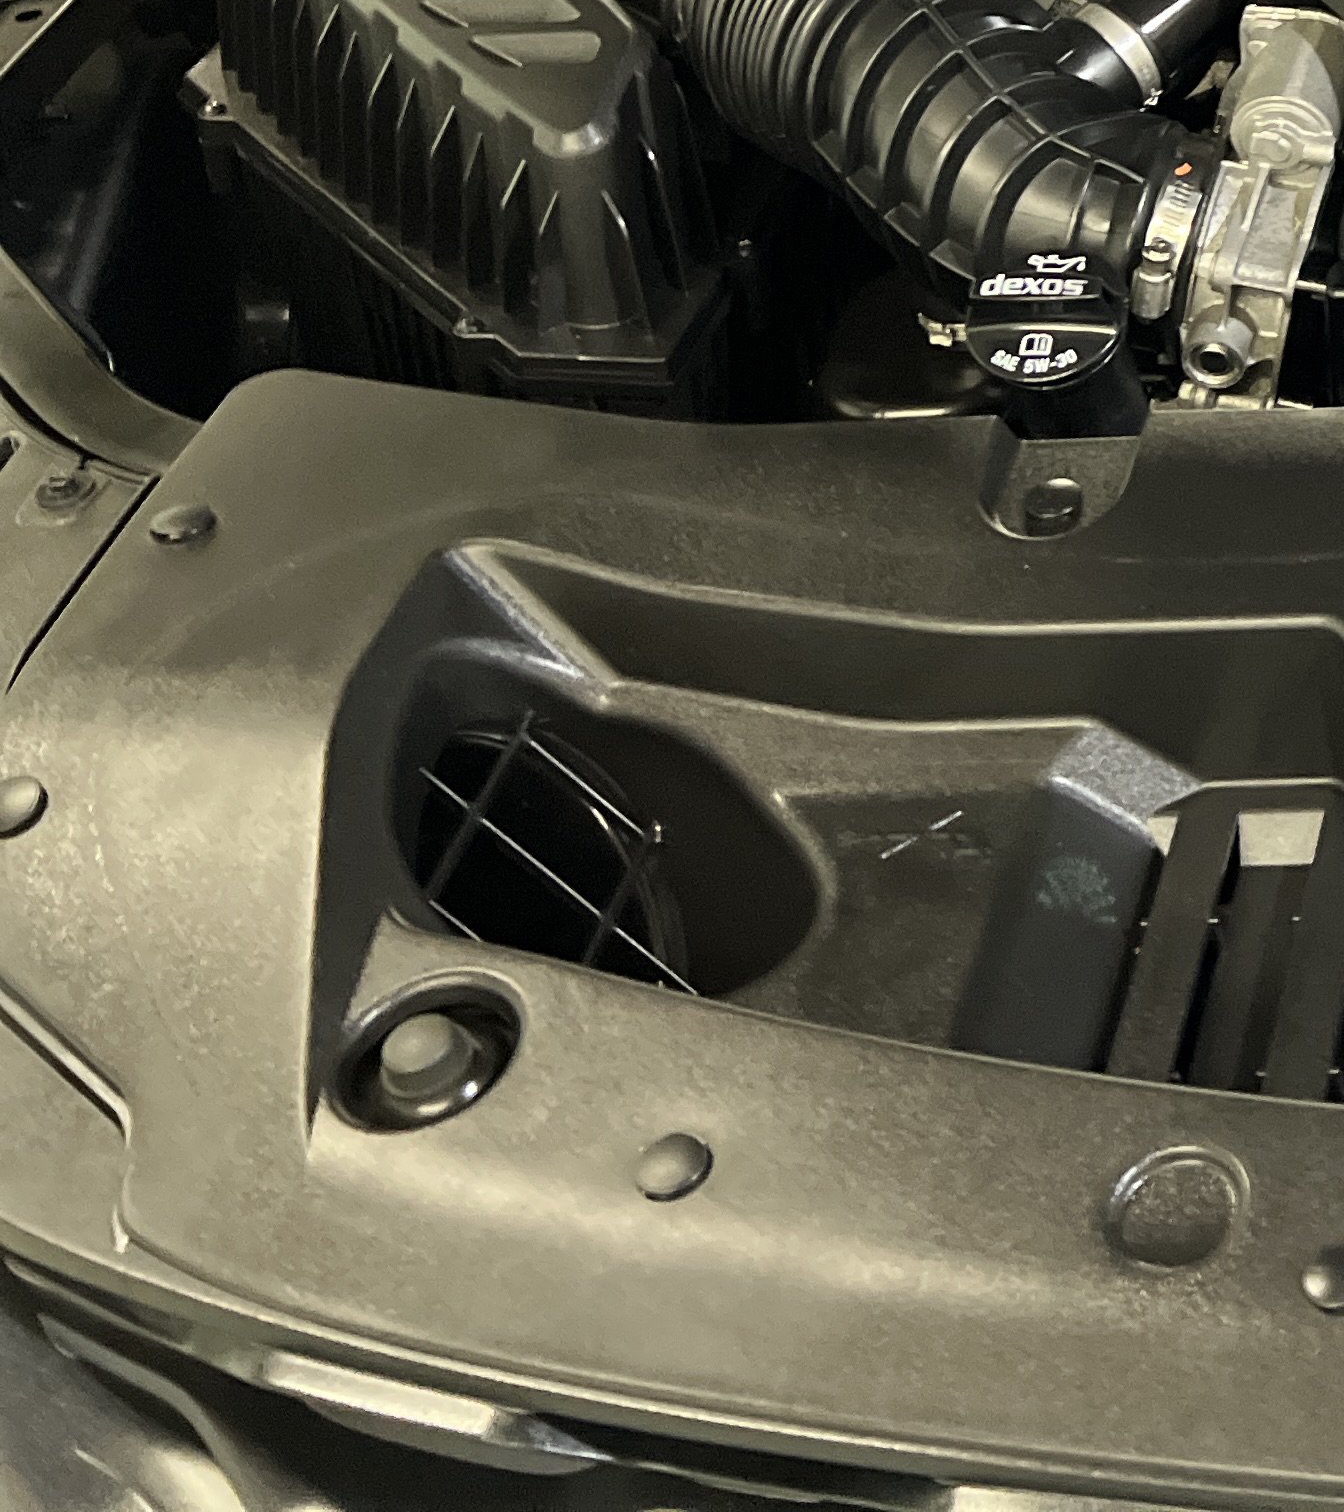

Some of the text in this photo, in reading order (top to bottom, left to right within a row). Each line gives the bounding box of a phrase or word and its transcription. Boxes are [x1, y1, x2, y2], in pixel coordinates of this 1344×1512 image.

[979, 273, 1089, 296] dexos
[990, 348, 1078, 374] SAE 5W-30
